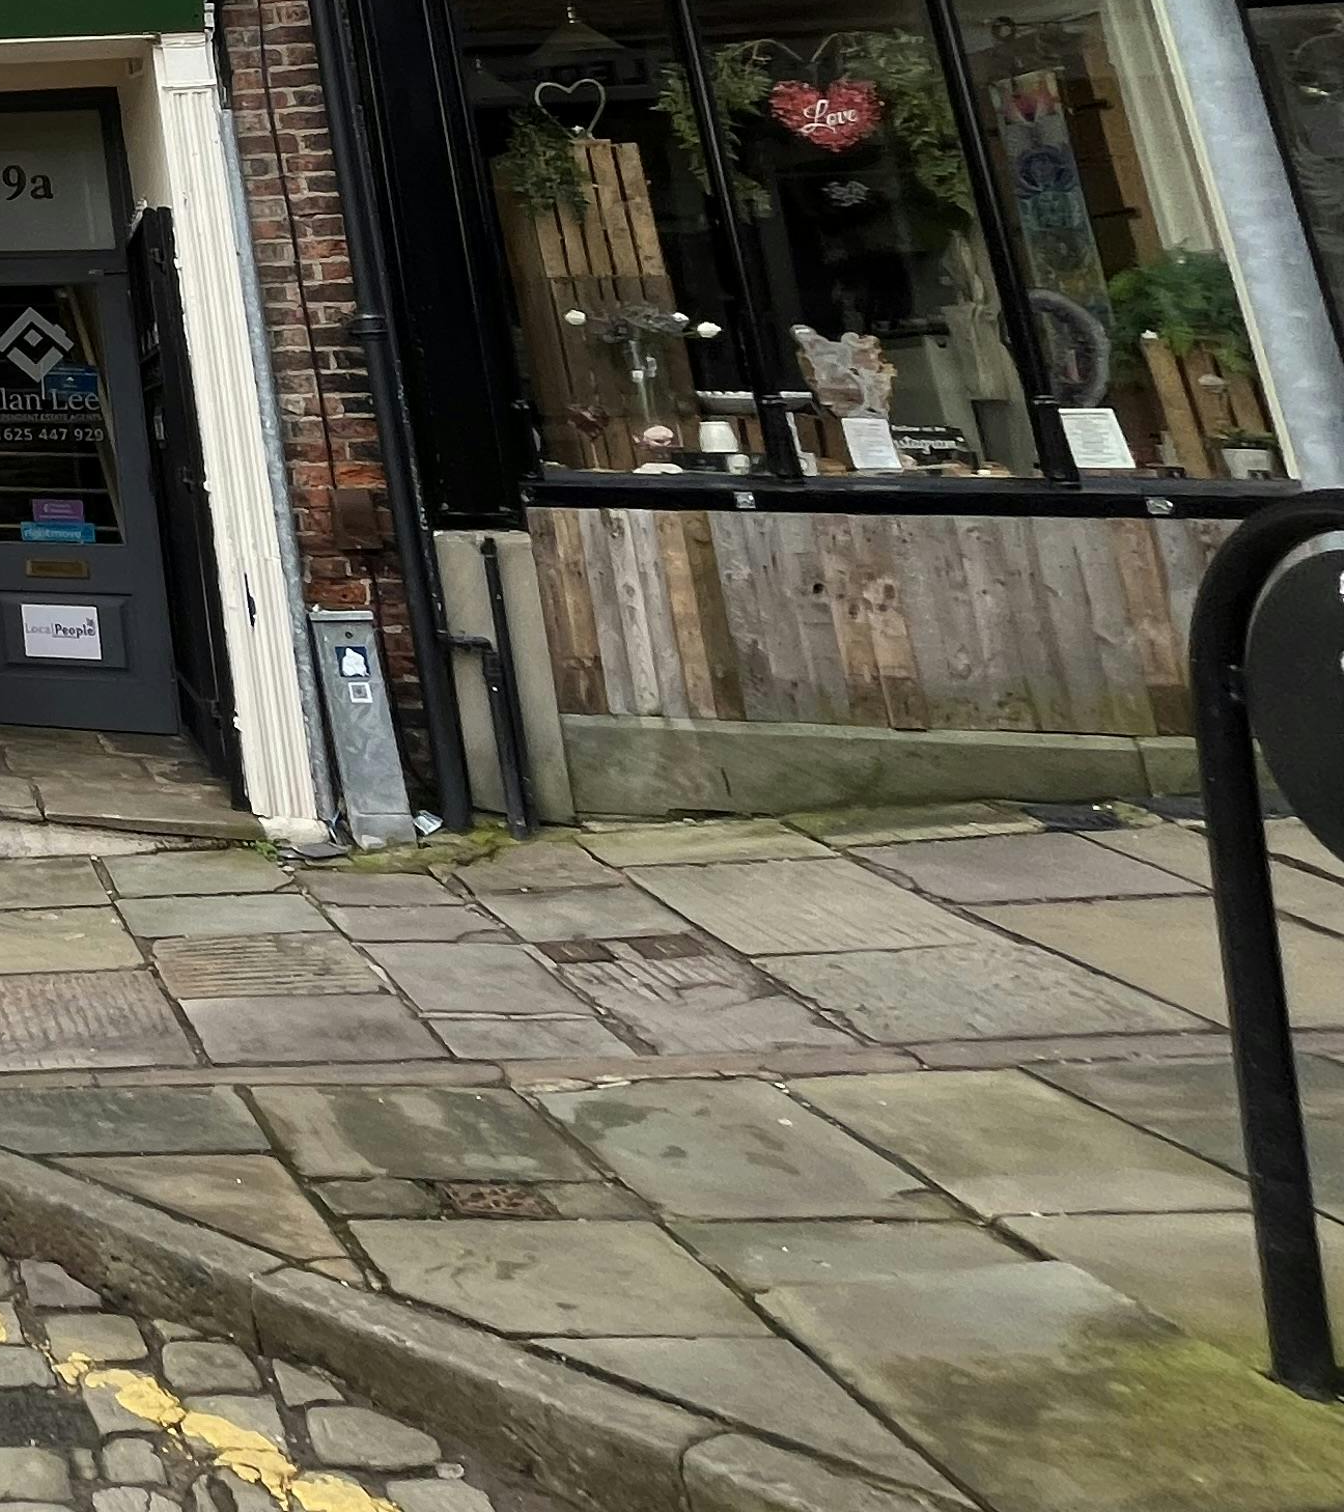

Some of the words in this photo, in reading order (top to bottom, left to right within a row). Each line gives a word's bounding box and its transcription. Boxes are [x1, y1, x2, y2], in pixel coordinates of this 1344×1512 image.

[799, 98, 858, 134] Love
[51, 388, 100, 411] Lee
[38, 428, 68, 441] 447
[73, 428, 105, 442] 929
